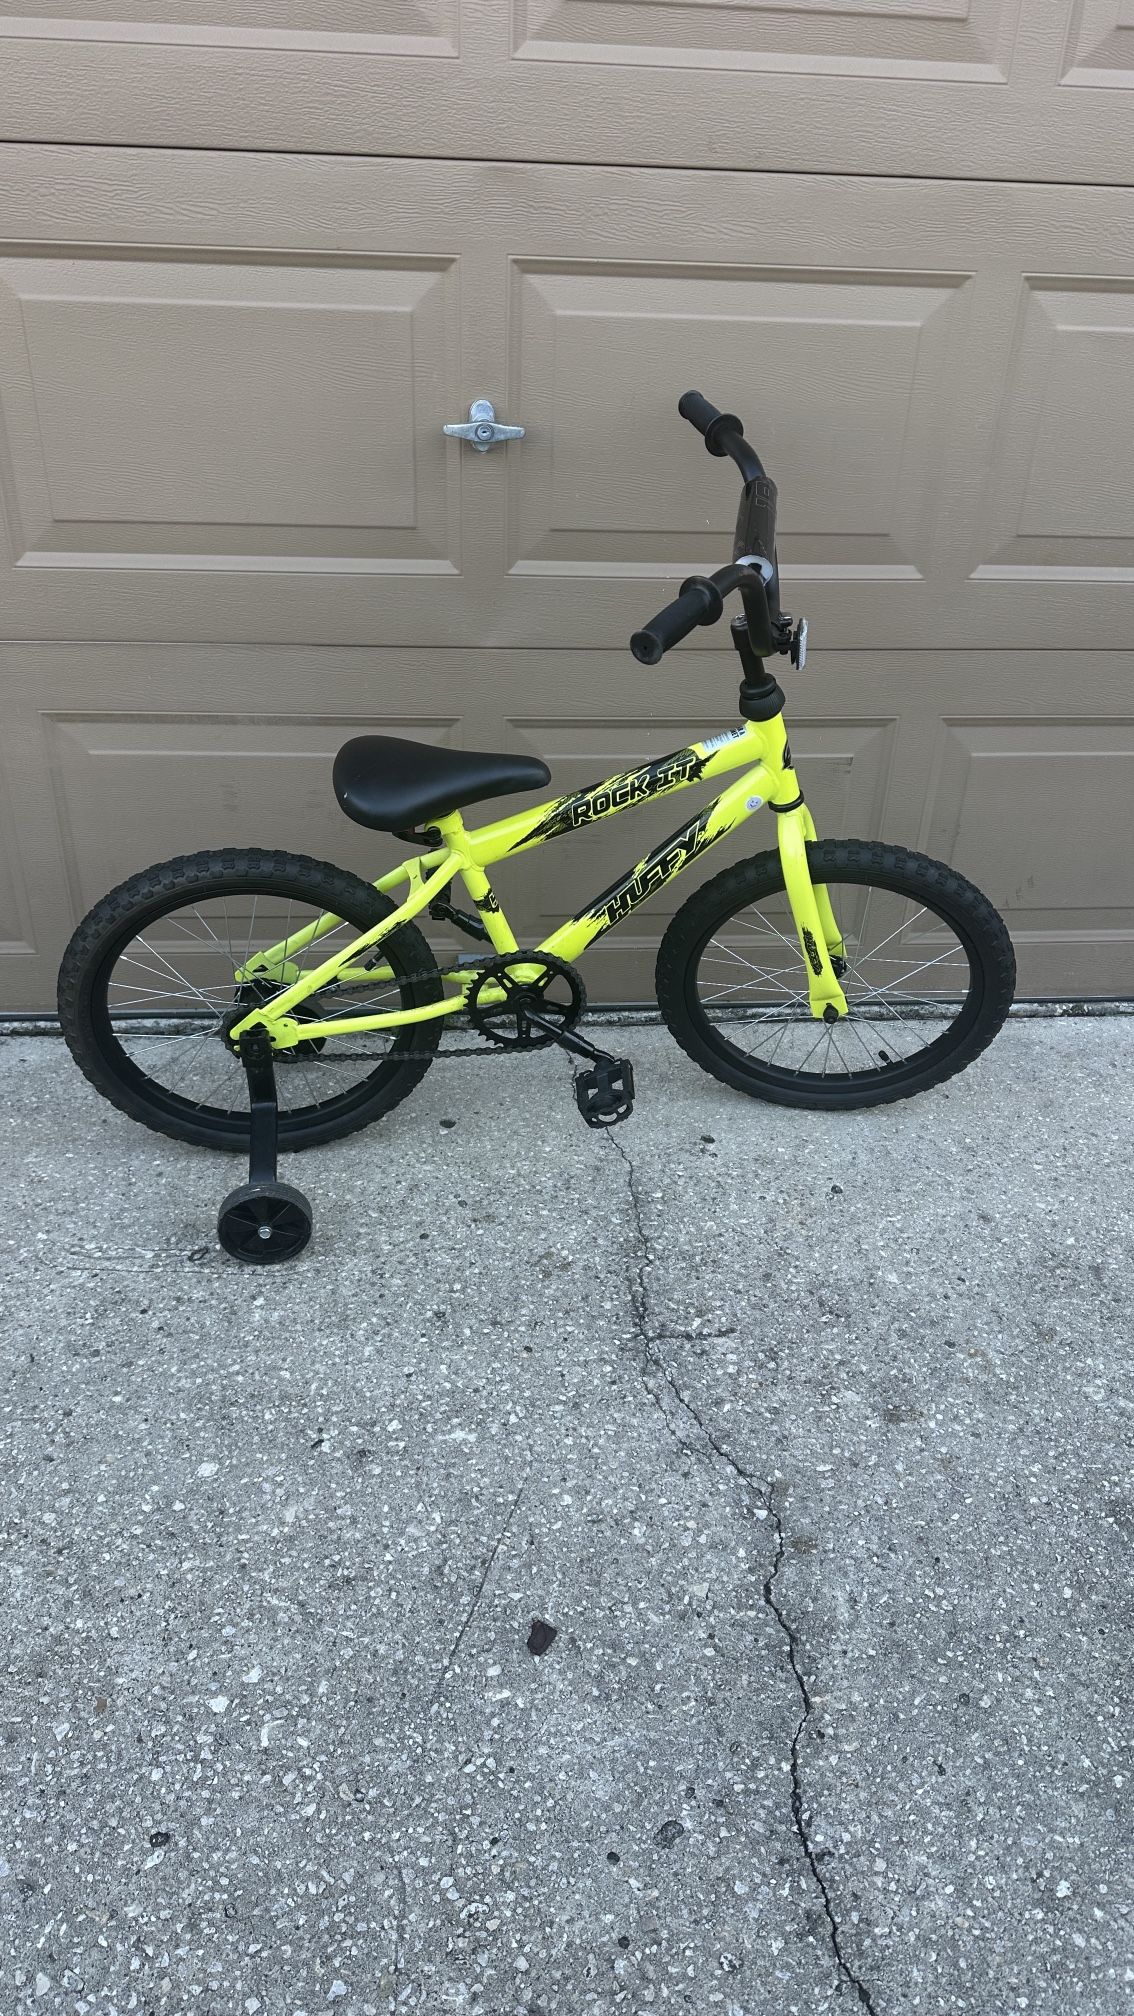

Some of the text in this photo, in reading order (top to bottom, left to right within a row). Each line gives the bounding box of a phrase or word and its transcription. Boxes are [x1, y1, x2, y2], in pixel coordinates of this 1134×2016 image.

[572, 756, 696, 827] ROCK IT
[605, 820, 701, 926] HUFFY
